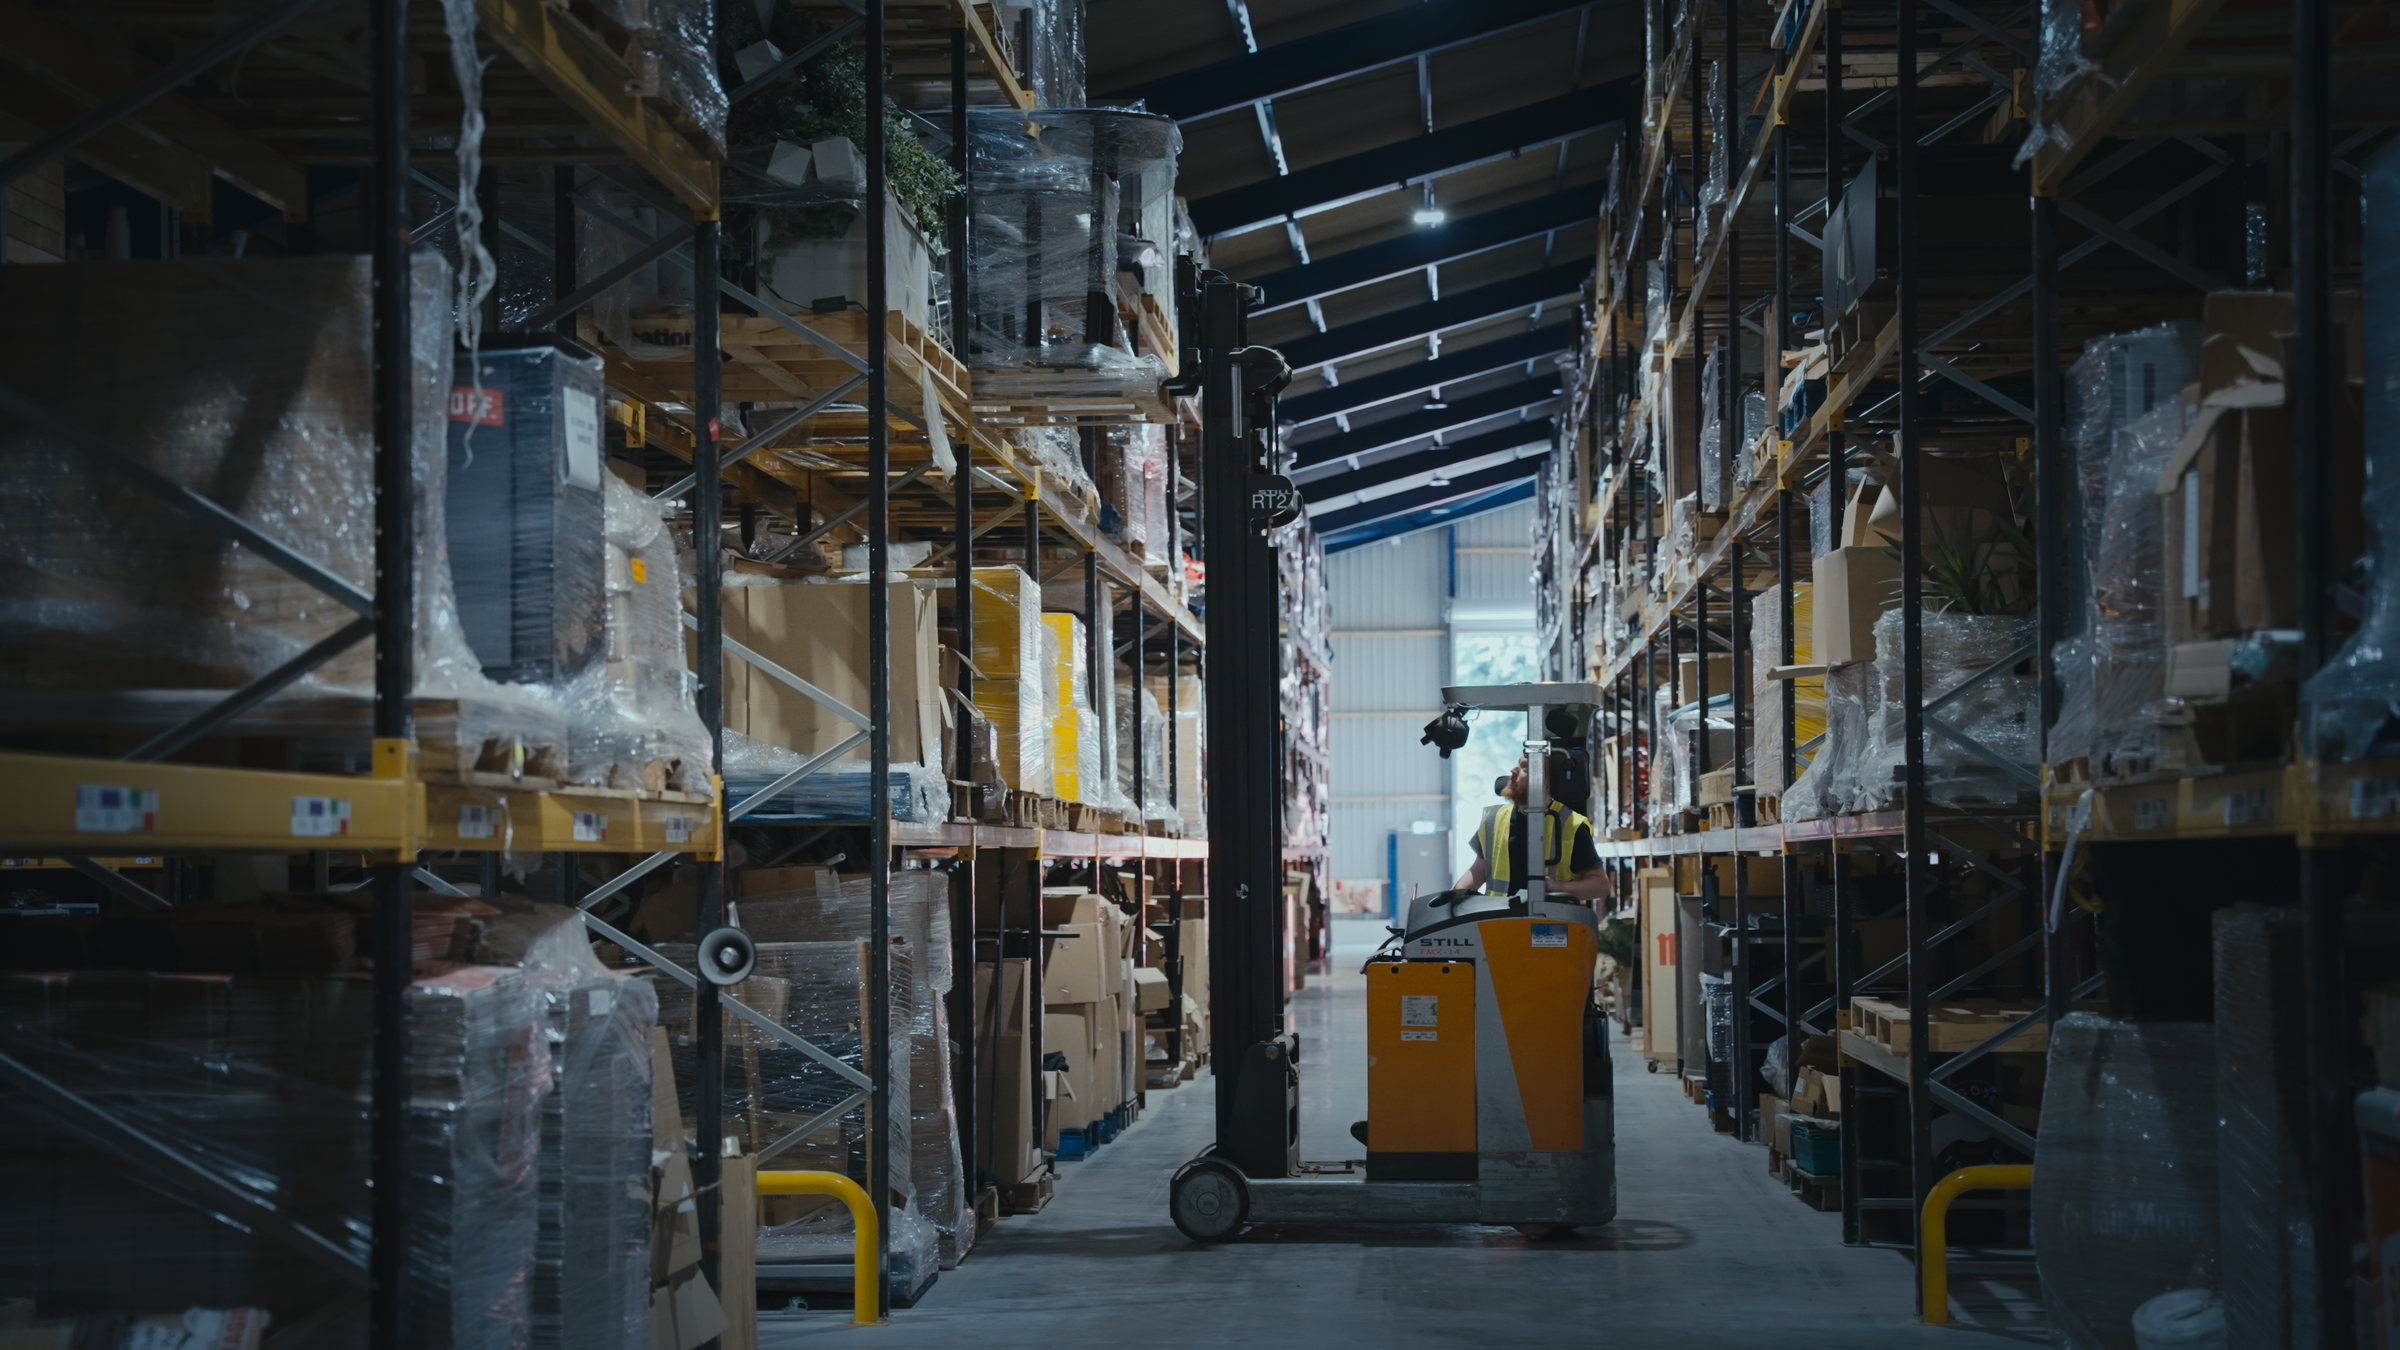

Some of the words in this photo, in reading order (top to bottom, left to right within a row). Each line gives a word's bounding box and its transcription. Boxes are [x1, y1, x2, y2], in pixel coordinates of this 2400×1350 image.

[1252, 494, 1287, 509] RT2
[1420, 938, 1475, 947] STILL
[1420, 948, 1461, 956] FMX-14
